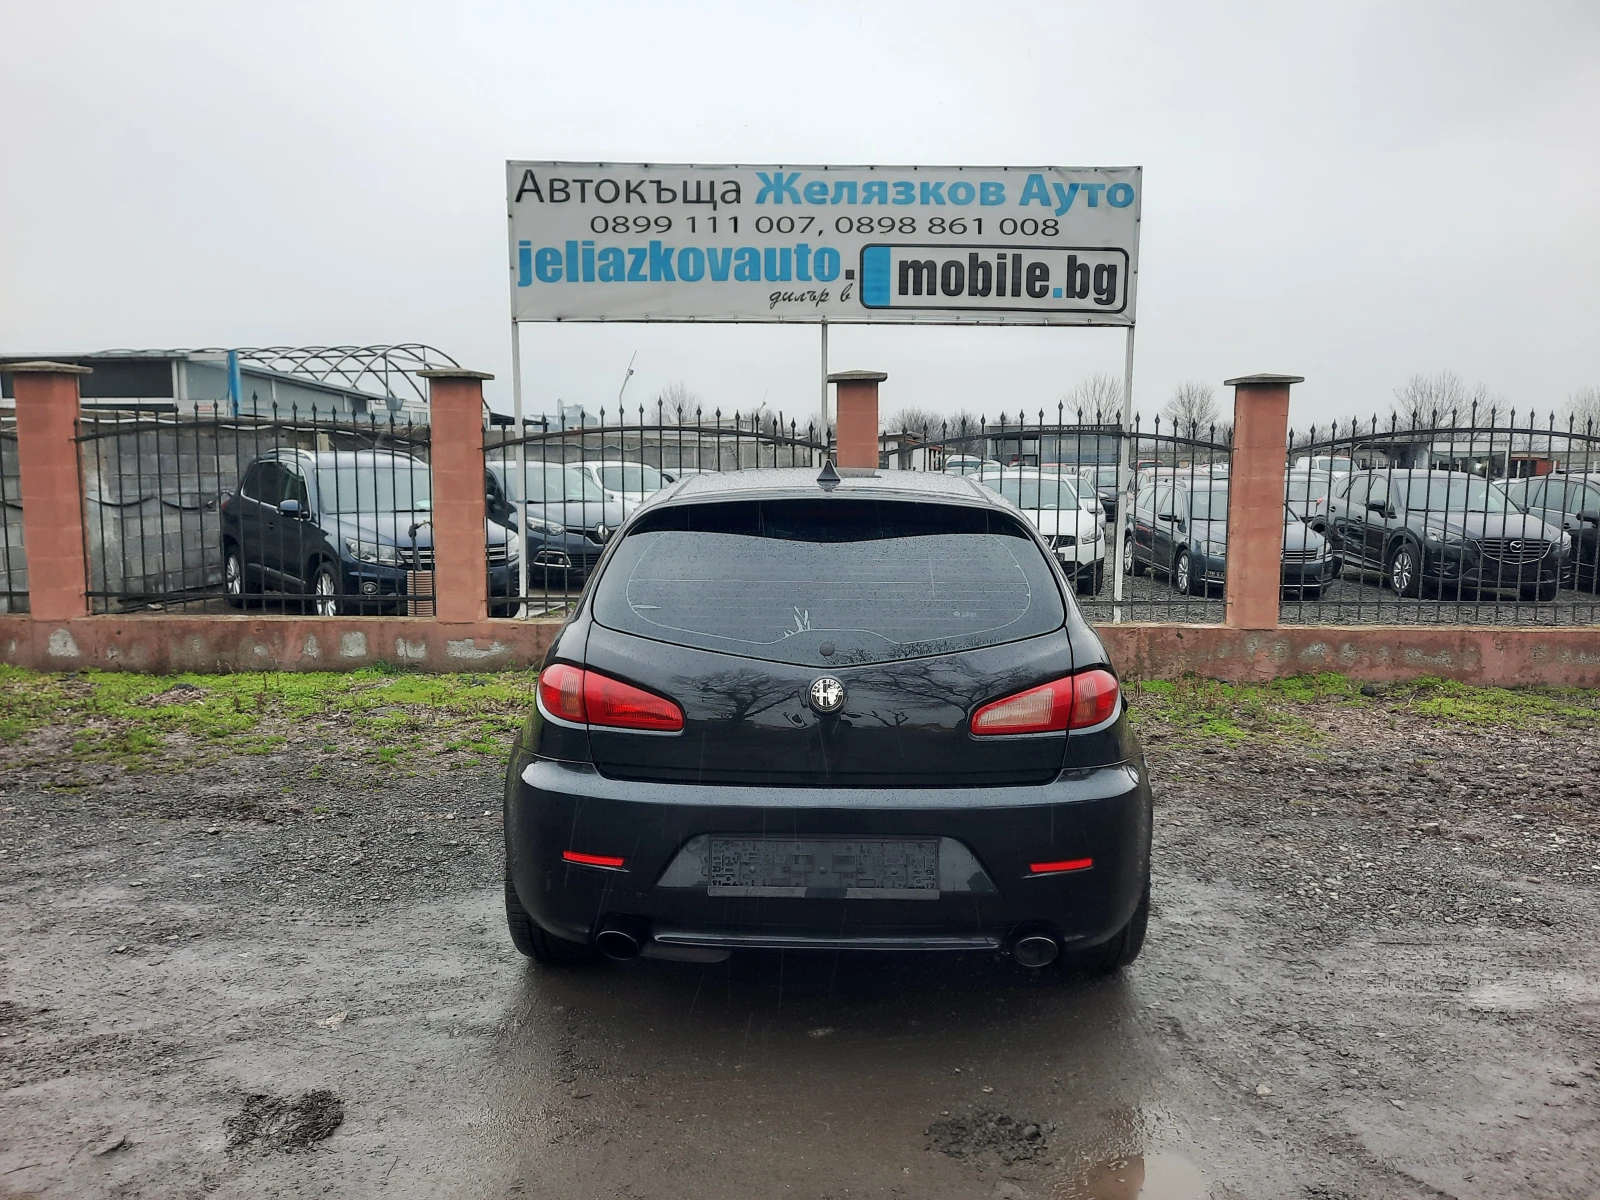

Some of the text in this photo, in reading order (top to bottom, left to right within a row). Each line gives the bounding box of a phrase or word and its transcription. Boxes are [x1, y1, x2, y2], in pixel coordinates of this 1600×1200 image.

[515, 169, 1134, 216] Автокъща Желязков Ауто
[590, 216, 1060, 236] 0899 111 007, 0898 861 008
[898, 253, 1118, 305] mobile.bg
[770, 288, 829, 309] дилър
